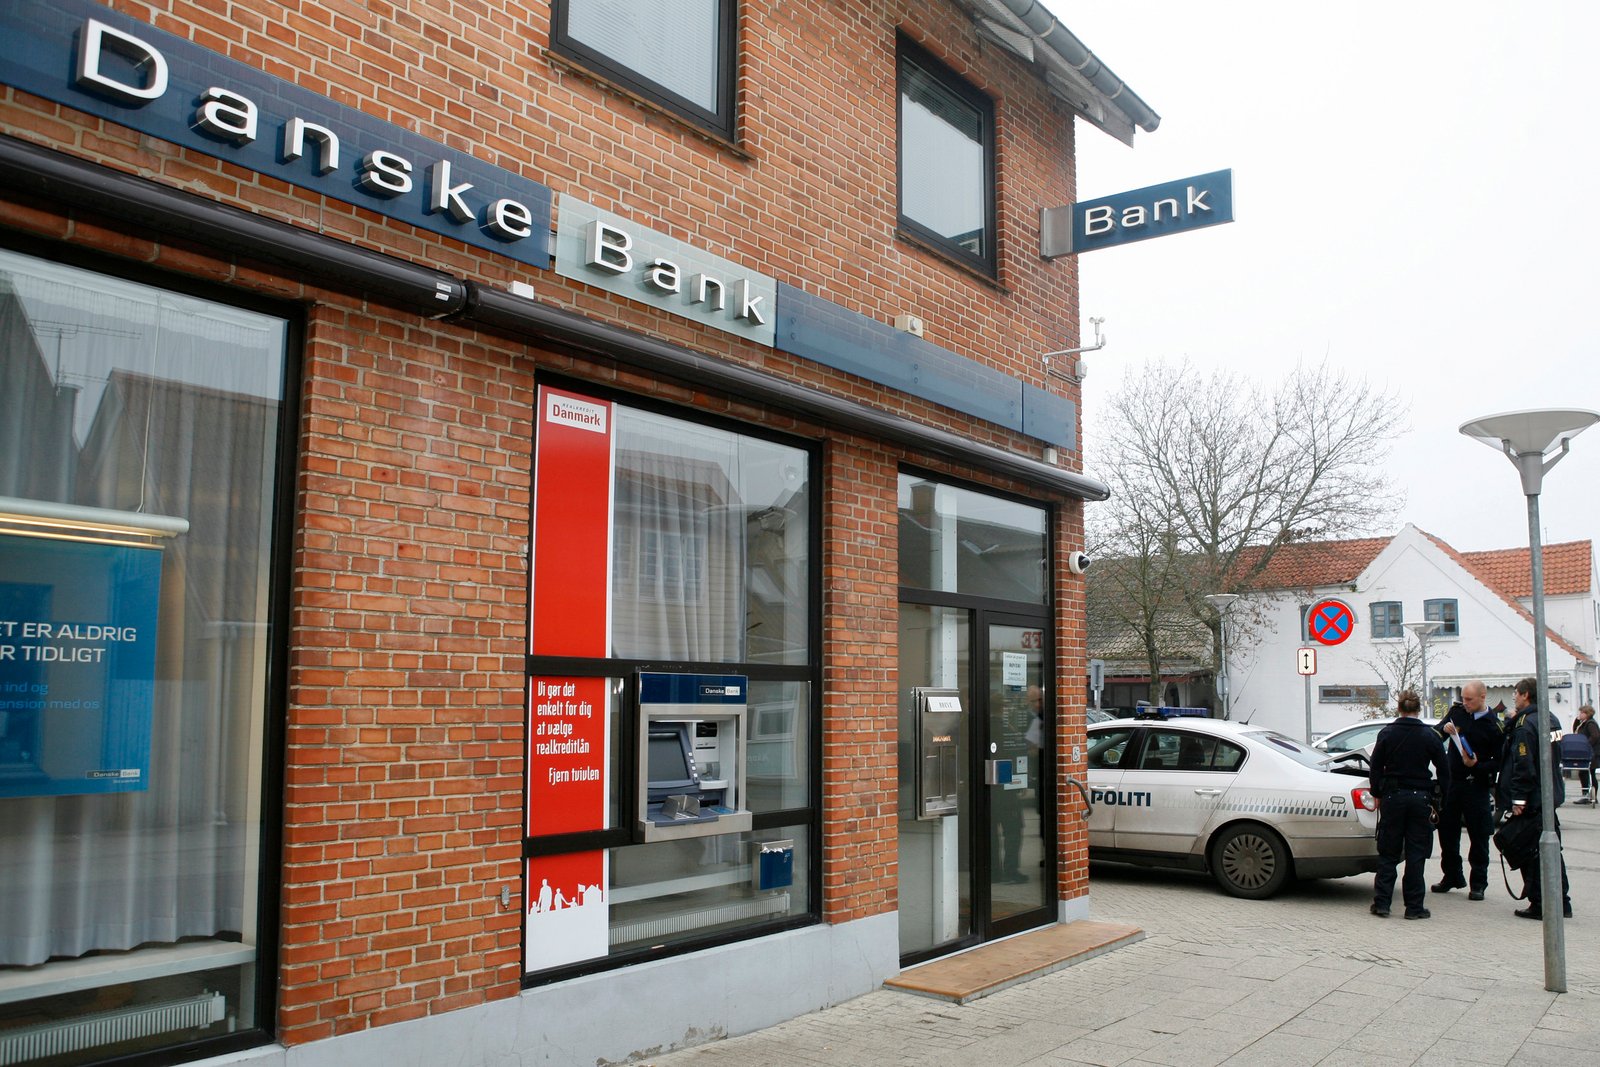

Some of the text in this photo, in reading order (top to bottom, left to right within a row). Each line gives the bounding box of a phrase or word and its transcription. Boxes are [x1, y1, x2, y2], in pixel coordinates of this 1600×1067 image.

[80, 18, 765, 325] Danske Bank
[1085, 186, 1212, 236] Bank
[553, 404, 601, 426] Danmark
[562, 403, 595, 413] REALKREDIT
[0, 621, 137, 642] T ER ALDRIG
[21, 646, 106, 662] TIDLIGT
[5, 682, 48, 695] ind og
[537, 681, 576, 699] Vi gør det
[49, 700, 81, 709] med
[83, 701, 100, 709] os
[537, 700, 592, 719] enkelt for dig
[536, 720, 573, 738] at vælge
[536, 738, 590, 755] realkreditlån
[548, 766, 600, 786] Fjern tvivlen
[1090, 790, 1152, 807] POLITI
